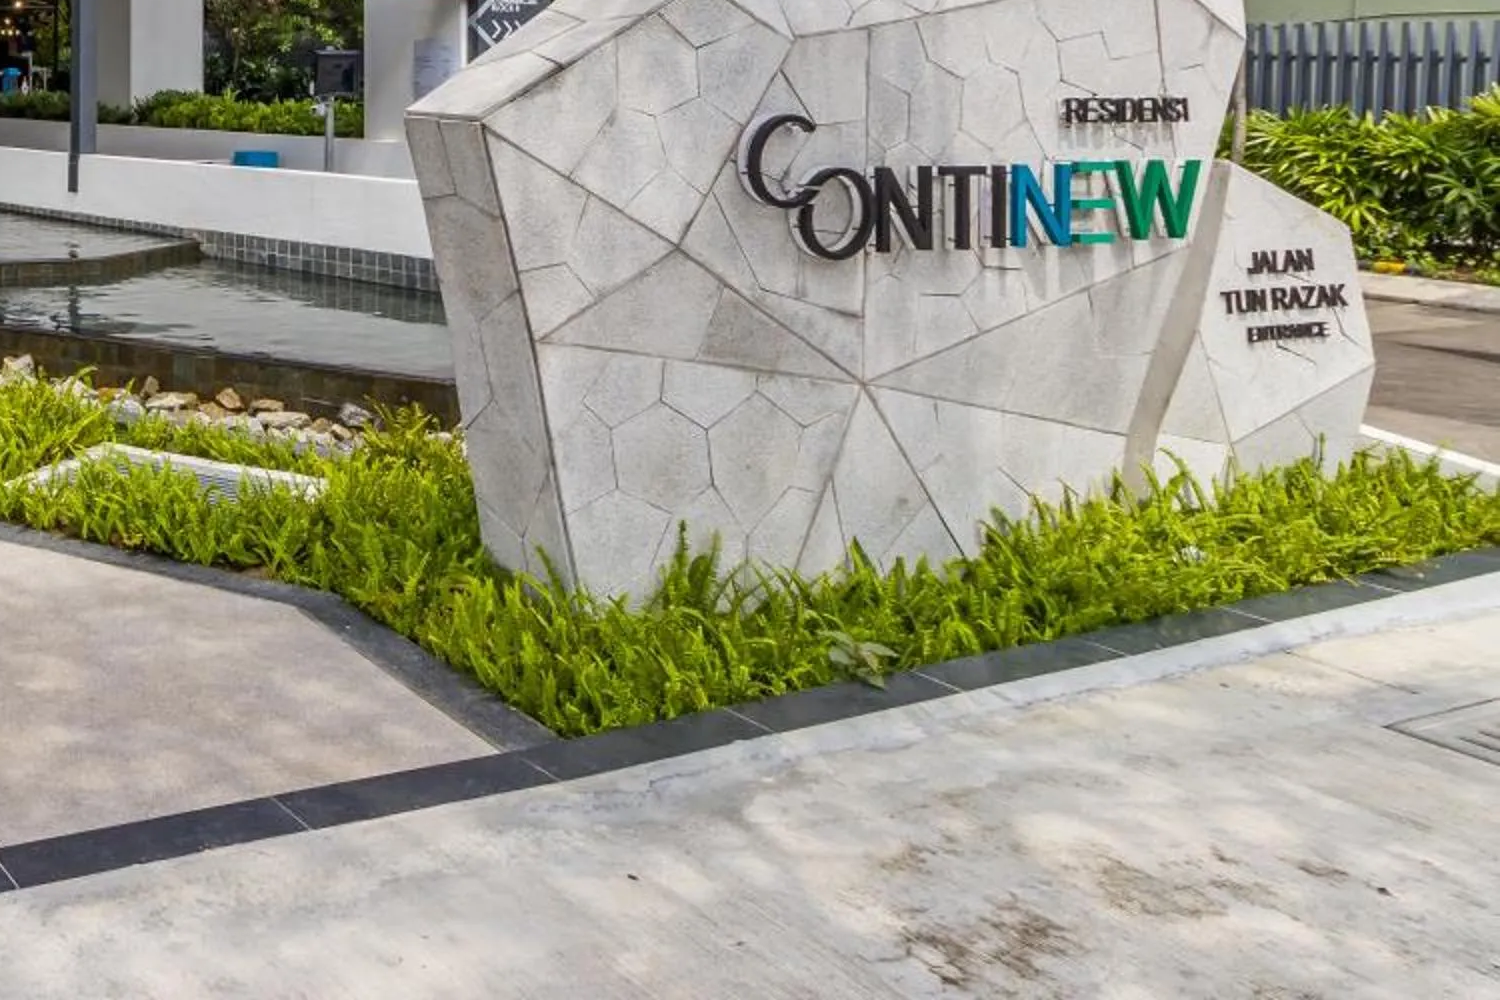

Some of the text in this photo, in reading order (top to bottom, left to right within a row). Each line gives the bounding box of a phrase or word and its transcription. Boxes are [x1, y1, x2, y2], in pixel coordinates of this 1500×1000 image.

[1063, 97, 1189, 123] RESIDENSI
[1247, 248, 1316, 275] JALAN
[1220, 283, 1349, 315] TUN RAZAK
